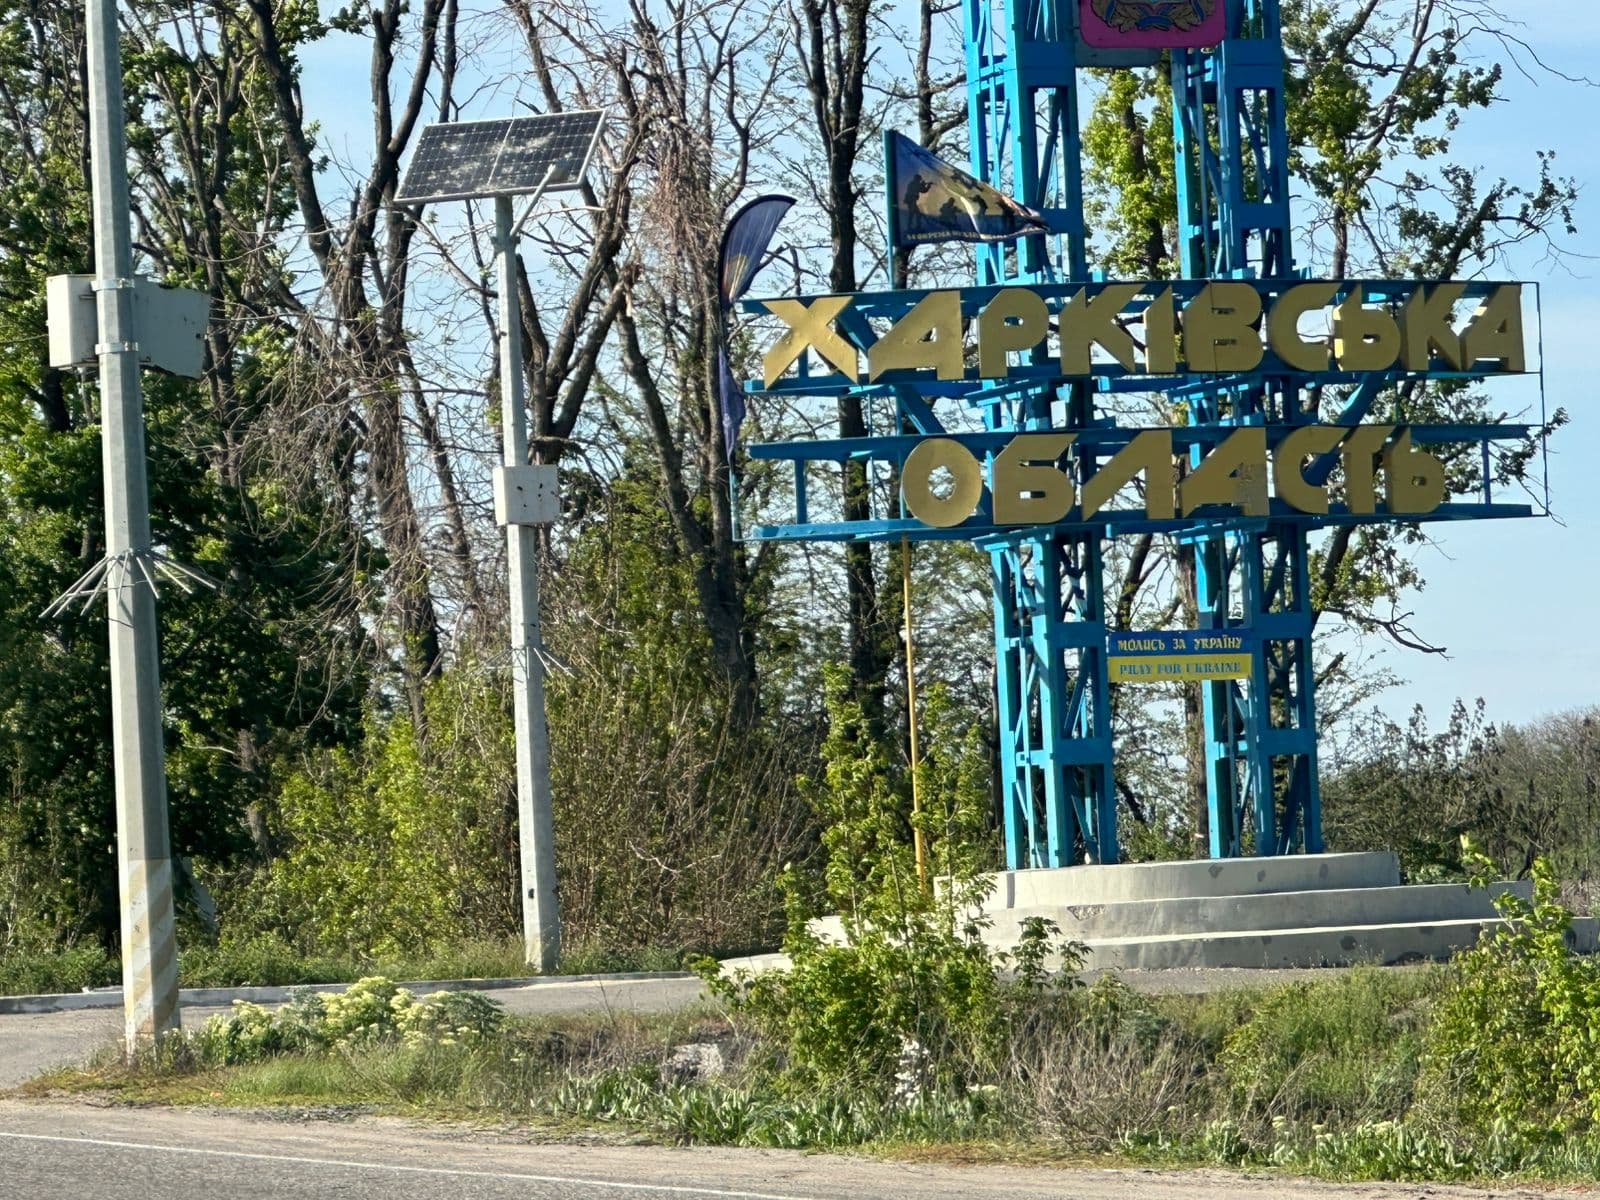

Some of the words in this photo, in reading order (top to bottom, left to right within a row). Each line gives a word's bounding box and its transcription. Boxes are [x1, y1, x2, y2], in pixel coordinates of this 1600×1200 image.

[762, 281, 1525, 389] ХАРКІВСЬКА
[901, 425, 1446, 527] ОБЛАСТЬ
[1117, 638, 1165, 651] МОЛИСЬ
[1172, 638, 1186, 650] ЗА
[1194, 634, 1242, 650] УКРАЇНУ
[1119, 664, 1152, 675] PRAY
[1158, 663, 1181, 674] FOR
[1186, 661, 1241, 674] UKRAINE
